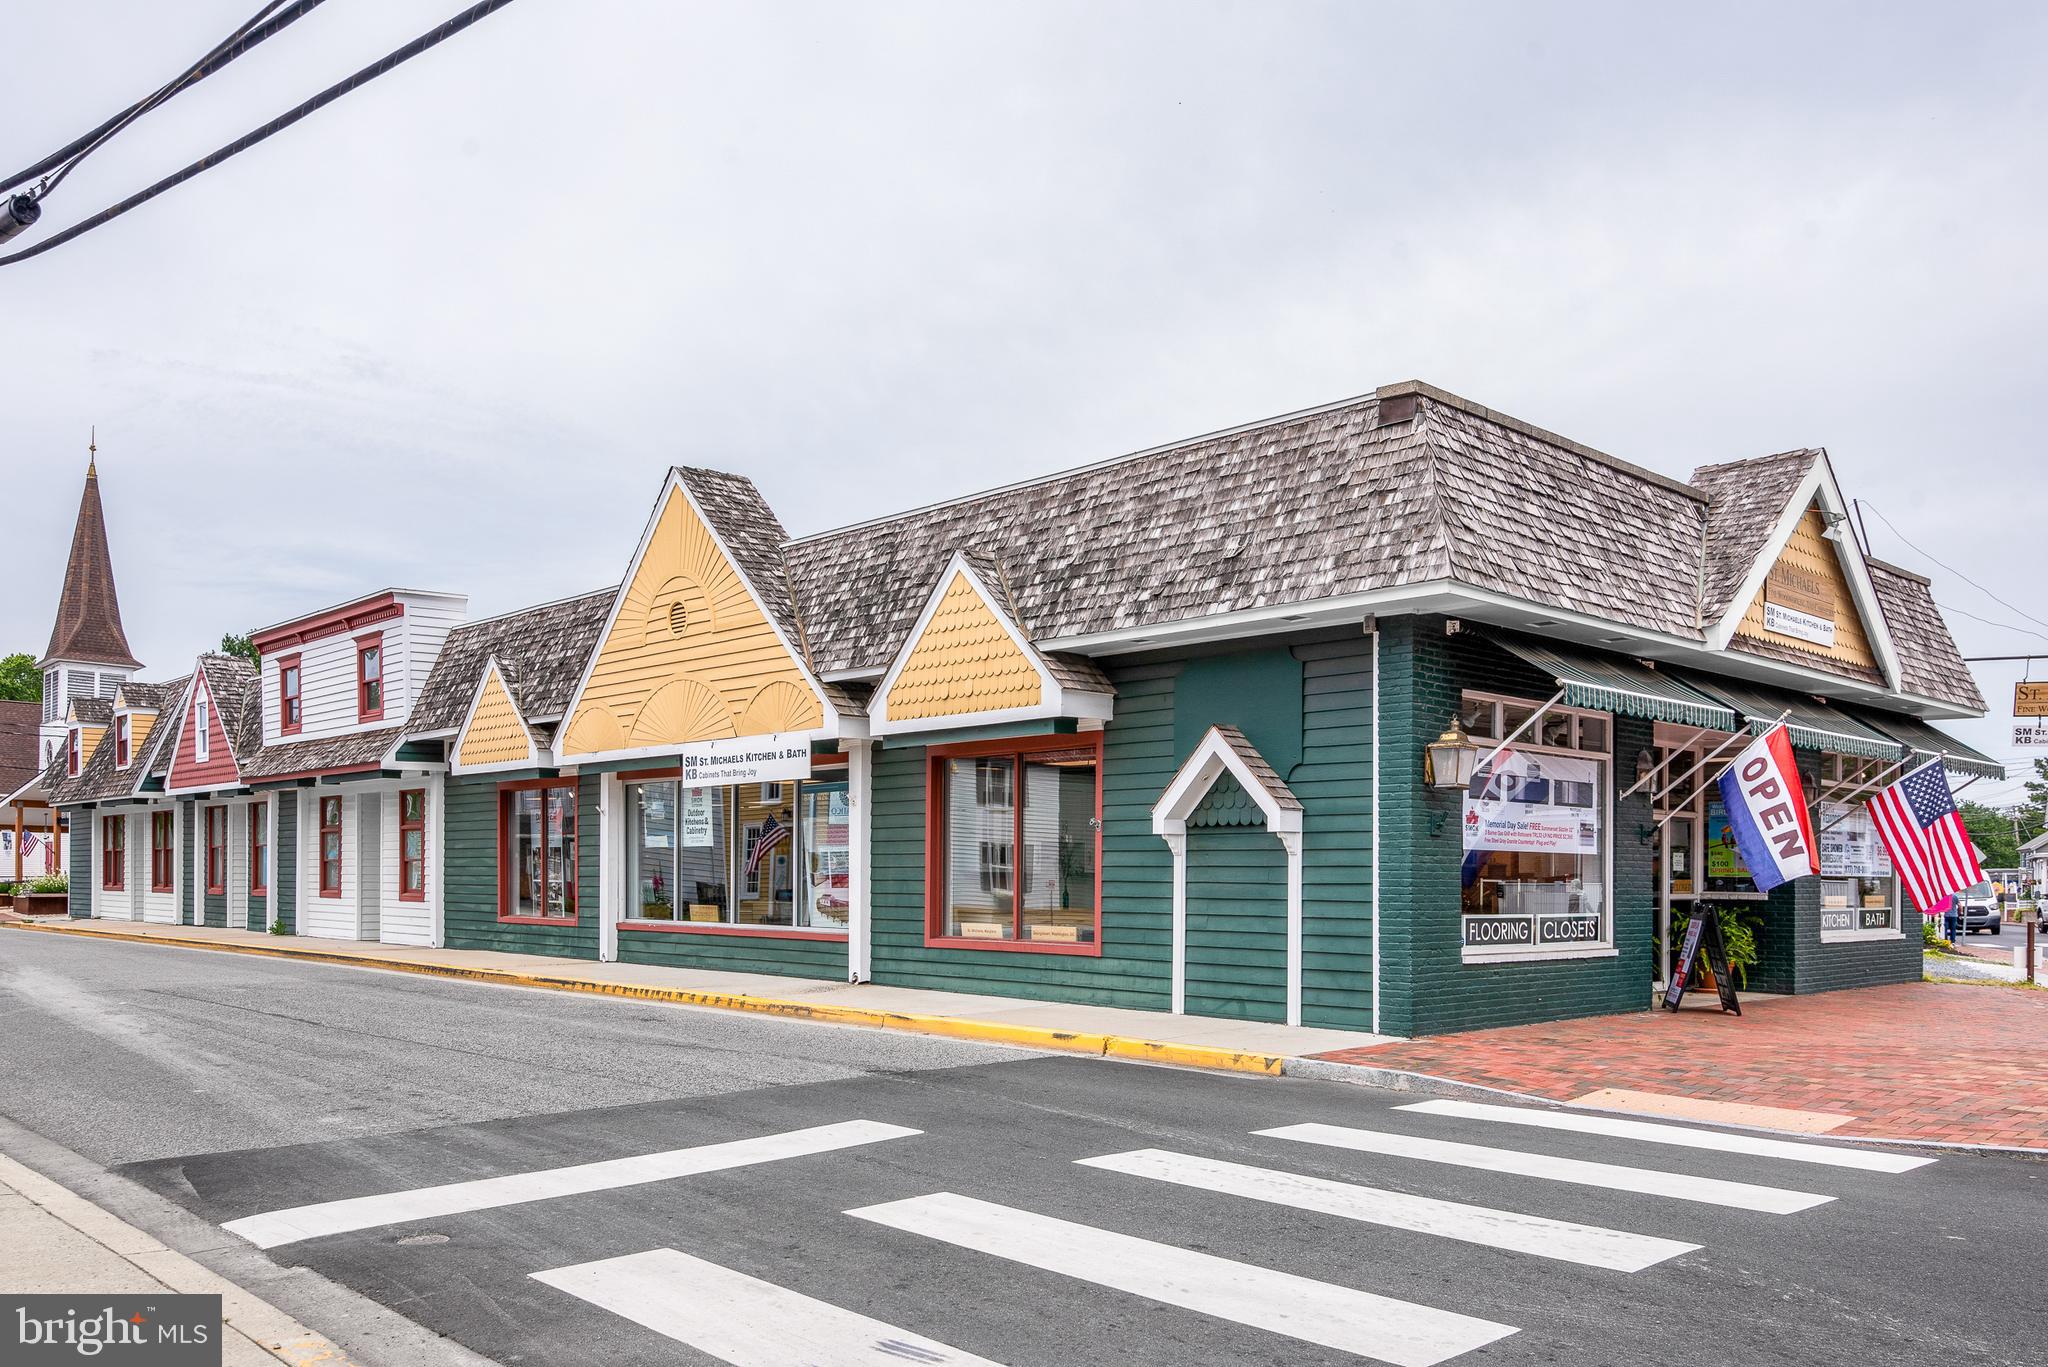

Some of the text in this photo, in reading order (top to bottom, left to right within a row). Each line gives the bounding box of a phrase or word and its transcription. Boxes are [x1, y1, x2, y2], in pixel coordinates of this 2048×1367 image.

[1781, 567, 1820, 595] MICHAELS
[1766, 606, 1775, 616] SM
[1766, 617, 1775, 627] KB
[2018, 686, 2042, 701] ST.
[2017, 705, 2035, 713] FINE
[2015, 736, 2032, 744] KB
[685, 756, 698, 767] SM
[699, 757, 709, 766] ST.
[710, 755, 744, 765] MICHAELS
[745, 752, 777, 762] KITCHEN
[786, 749, 807, 758] BATH
[685, 769, 698, 780] KB
[699, 768, 757, 779] Cabinets That Bring Joy
[688, 809, 705, 817] Outdoor
[1742, 757, 1805, 860] OPEN
[1485, 820, 1507, 829] Memorial
[1507, 821, 1516, 830] Day
[1517, 822, 1529, 830] Sale!
[1529, 822, 1541, 831] FREE
[686, 827, 708, 836] Cabinetry
[1822, 913, 1850, 928] KITCHEN
[1865, 912, 1885, 926] BATH
[1469, 922, 1528, 941] FLOORING
[1543, 920, 1596, 939] CLOSETS
